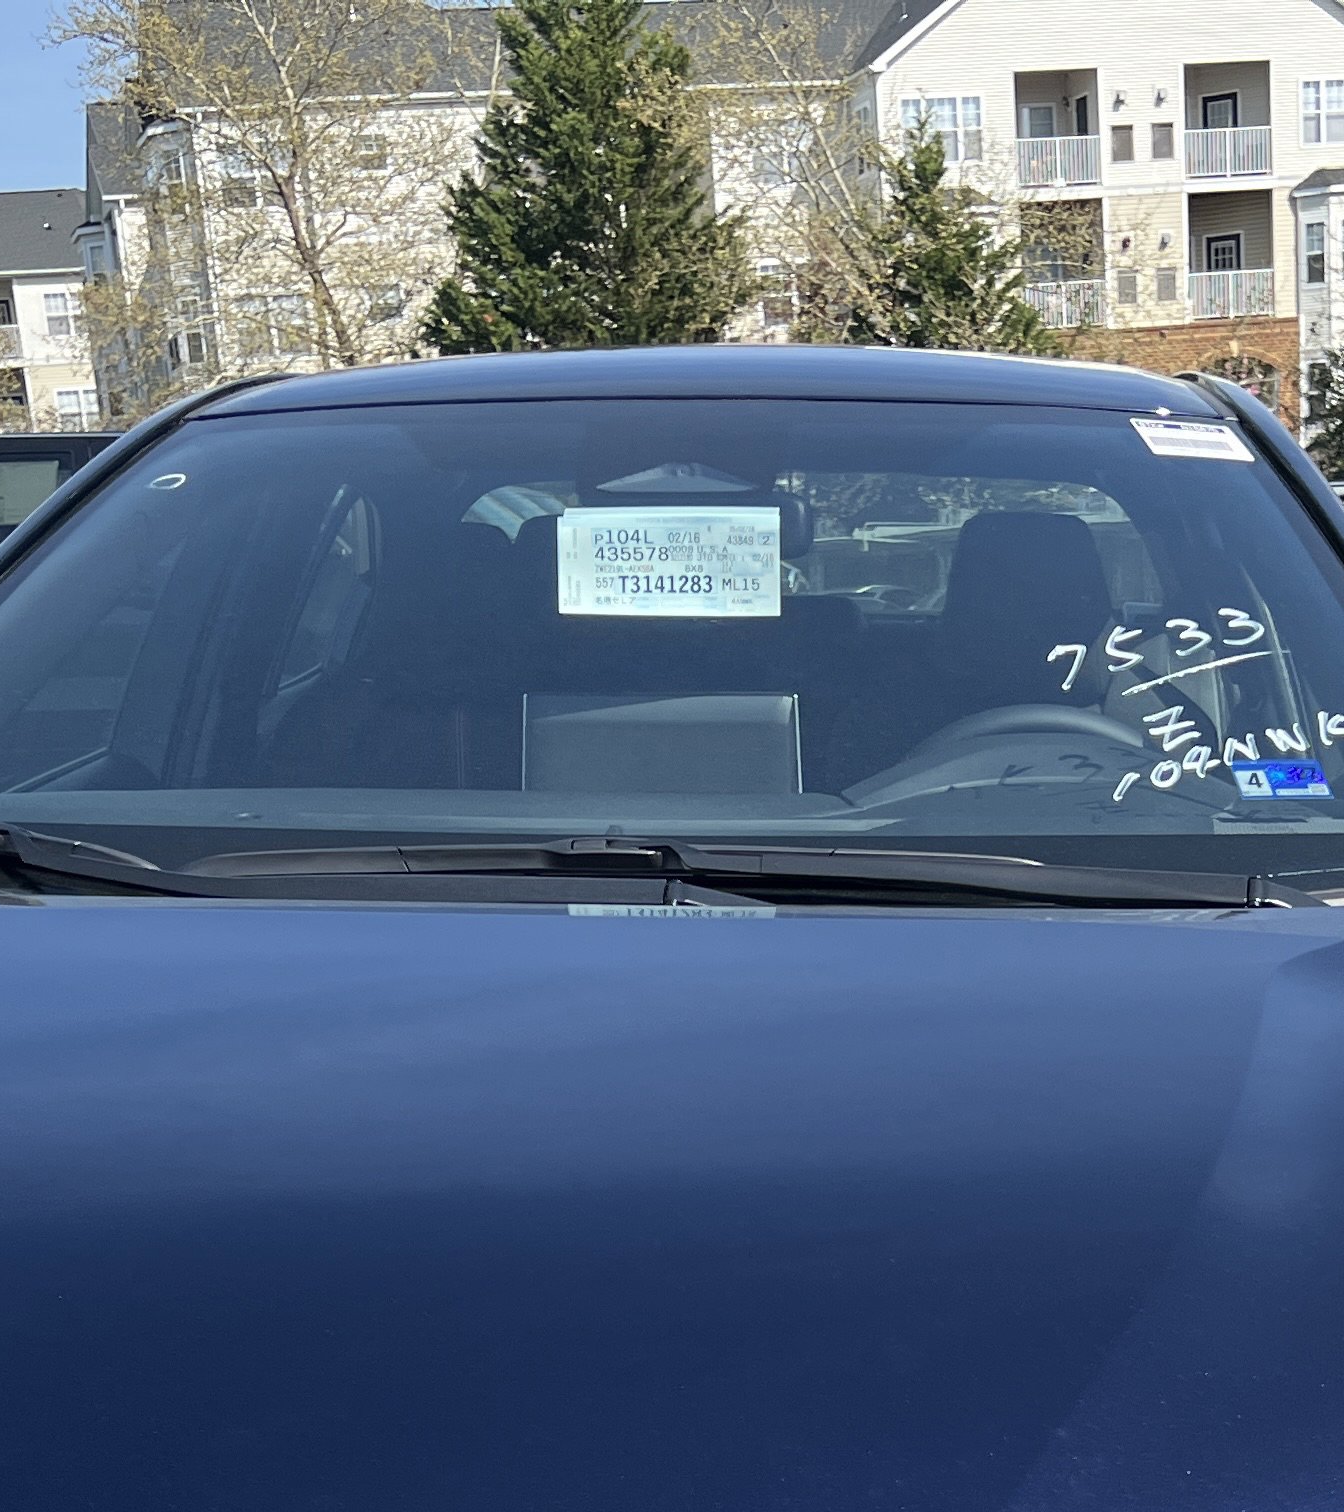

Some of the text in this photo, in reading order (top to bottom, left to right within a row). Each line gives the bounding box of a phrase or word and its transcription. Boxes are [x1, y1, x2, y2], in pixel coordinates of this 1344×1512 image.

[594, 529, 654, 545] P104L
[667, 531, 701, 544] 02/16
[761, 536, 770, 545] 2
[594, 546, 669, 562] 435578
[595, 574, 760, 594] 557 T3141283 ML15
[1046, 606, 1265, 691] 7533
[1248, 772, 1264, 788] 4
